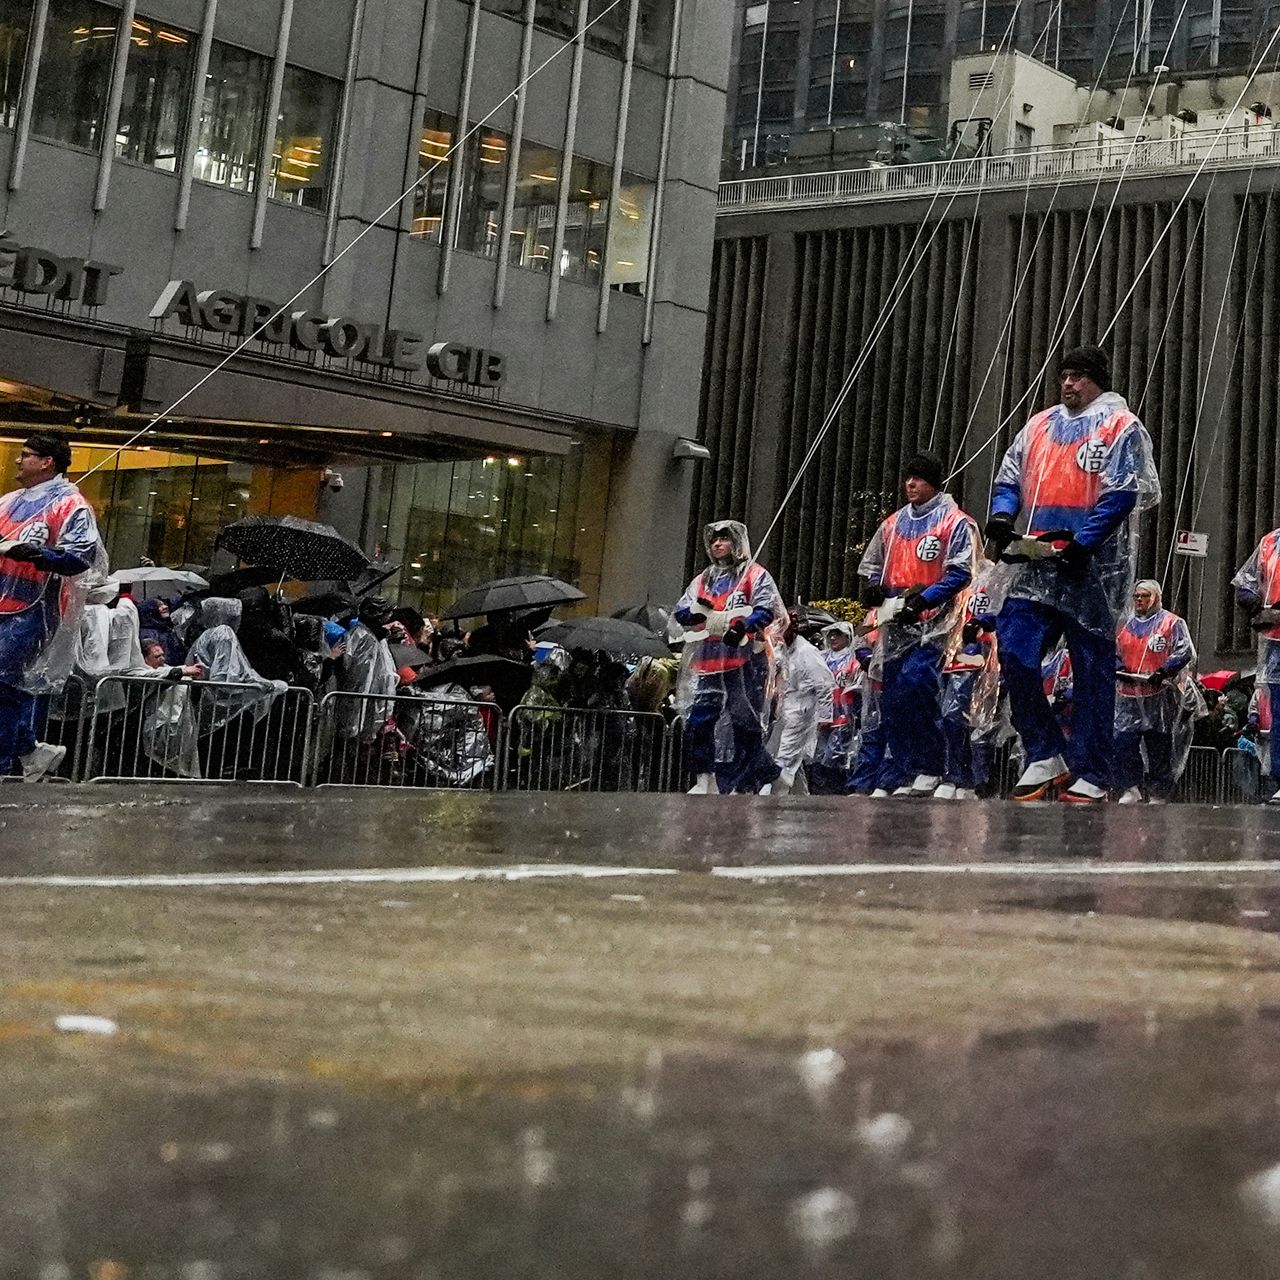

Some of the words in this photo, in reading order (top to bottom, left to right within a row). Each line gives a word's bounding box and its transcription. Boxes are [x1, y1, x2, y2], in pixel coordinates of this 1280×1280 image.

[149, 279, 424, 371] AGRICOLE
[426, 342, 508, 388] CIB
[1080, 440, 1107, 470] 悟
[918, 536, 940, 560] 悟
